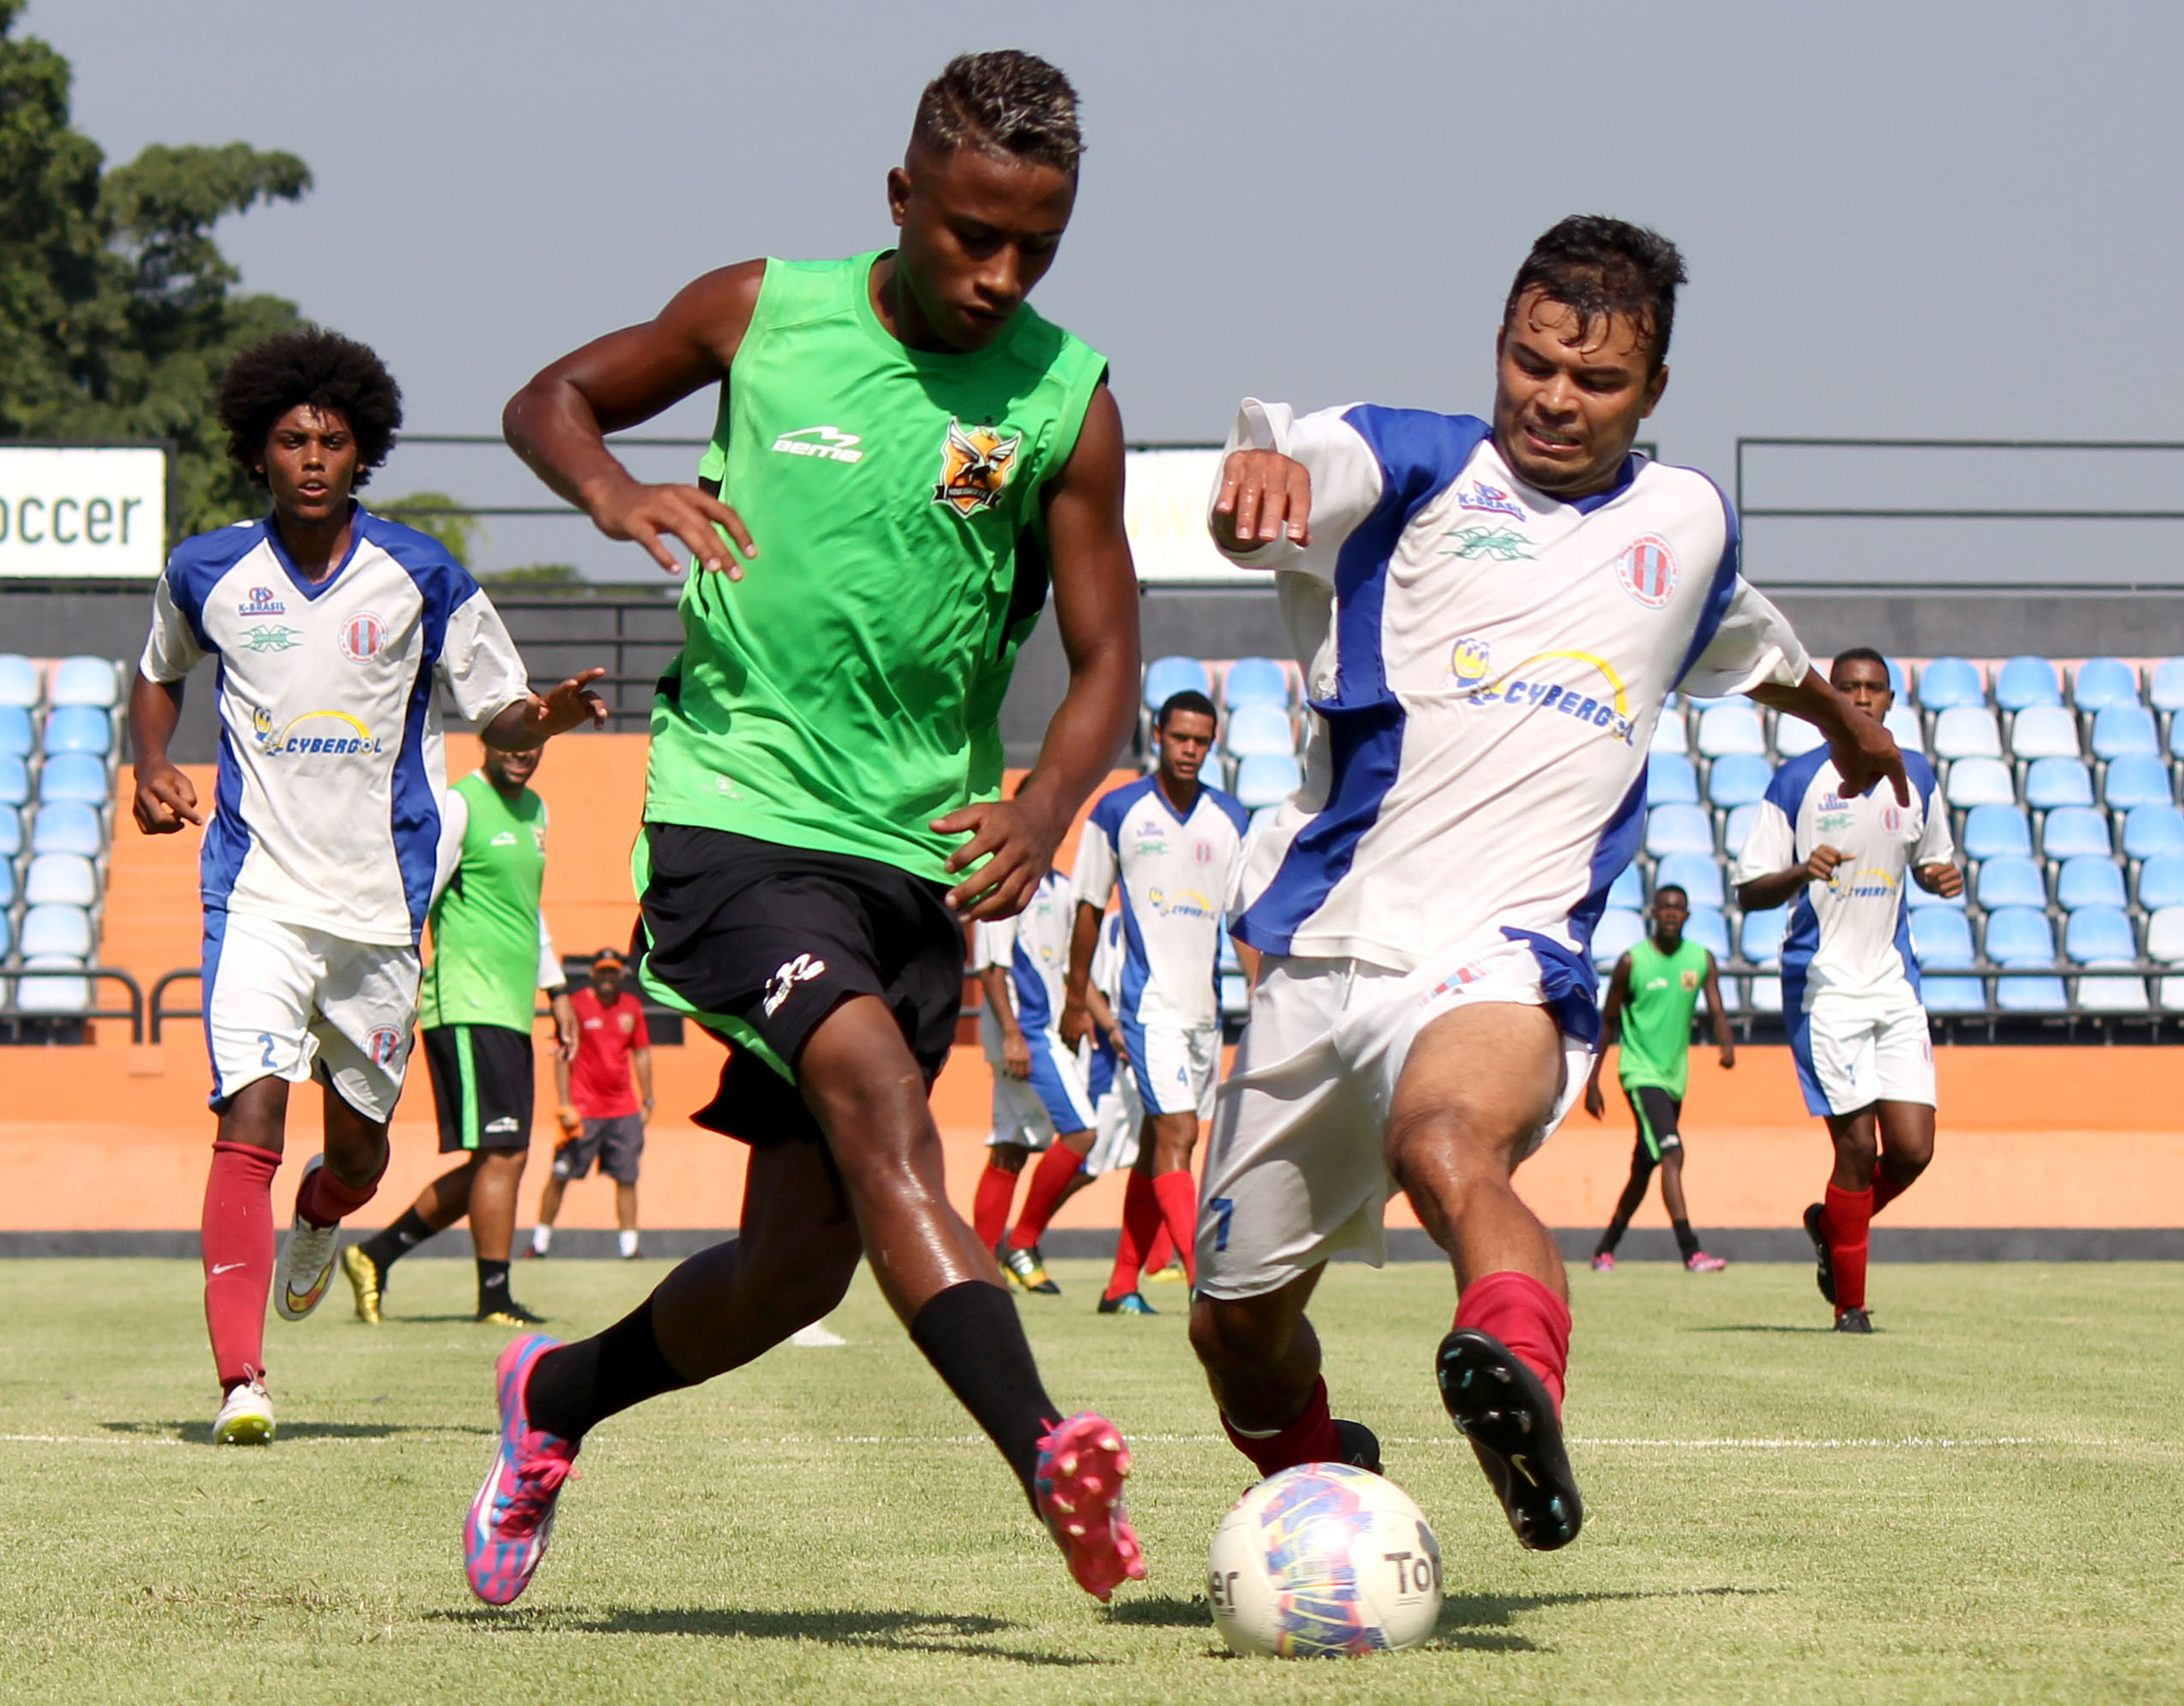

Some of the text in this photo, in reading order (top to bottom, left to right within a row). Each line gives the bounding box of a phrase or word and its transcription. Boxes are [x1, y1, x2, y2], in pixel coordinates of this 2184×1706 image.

[239, 601, 286, 613] K-BRASIL
[258, 1033, 277, 1067] 2
[1177, 1065, 1189, 1088] 4
[1208, 1197, 1233, 1251] 7
